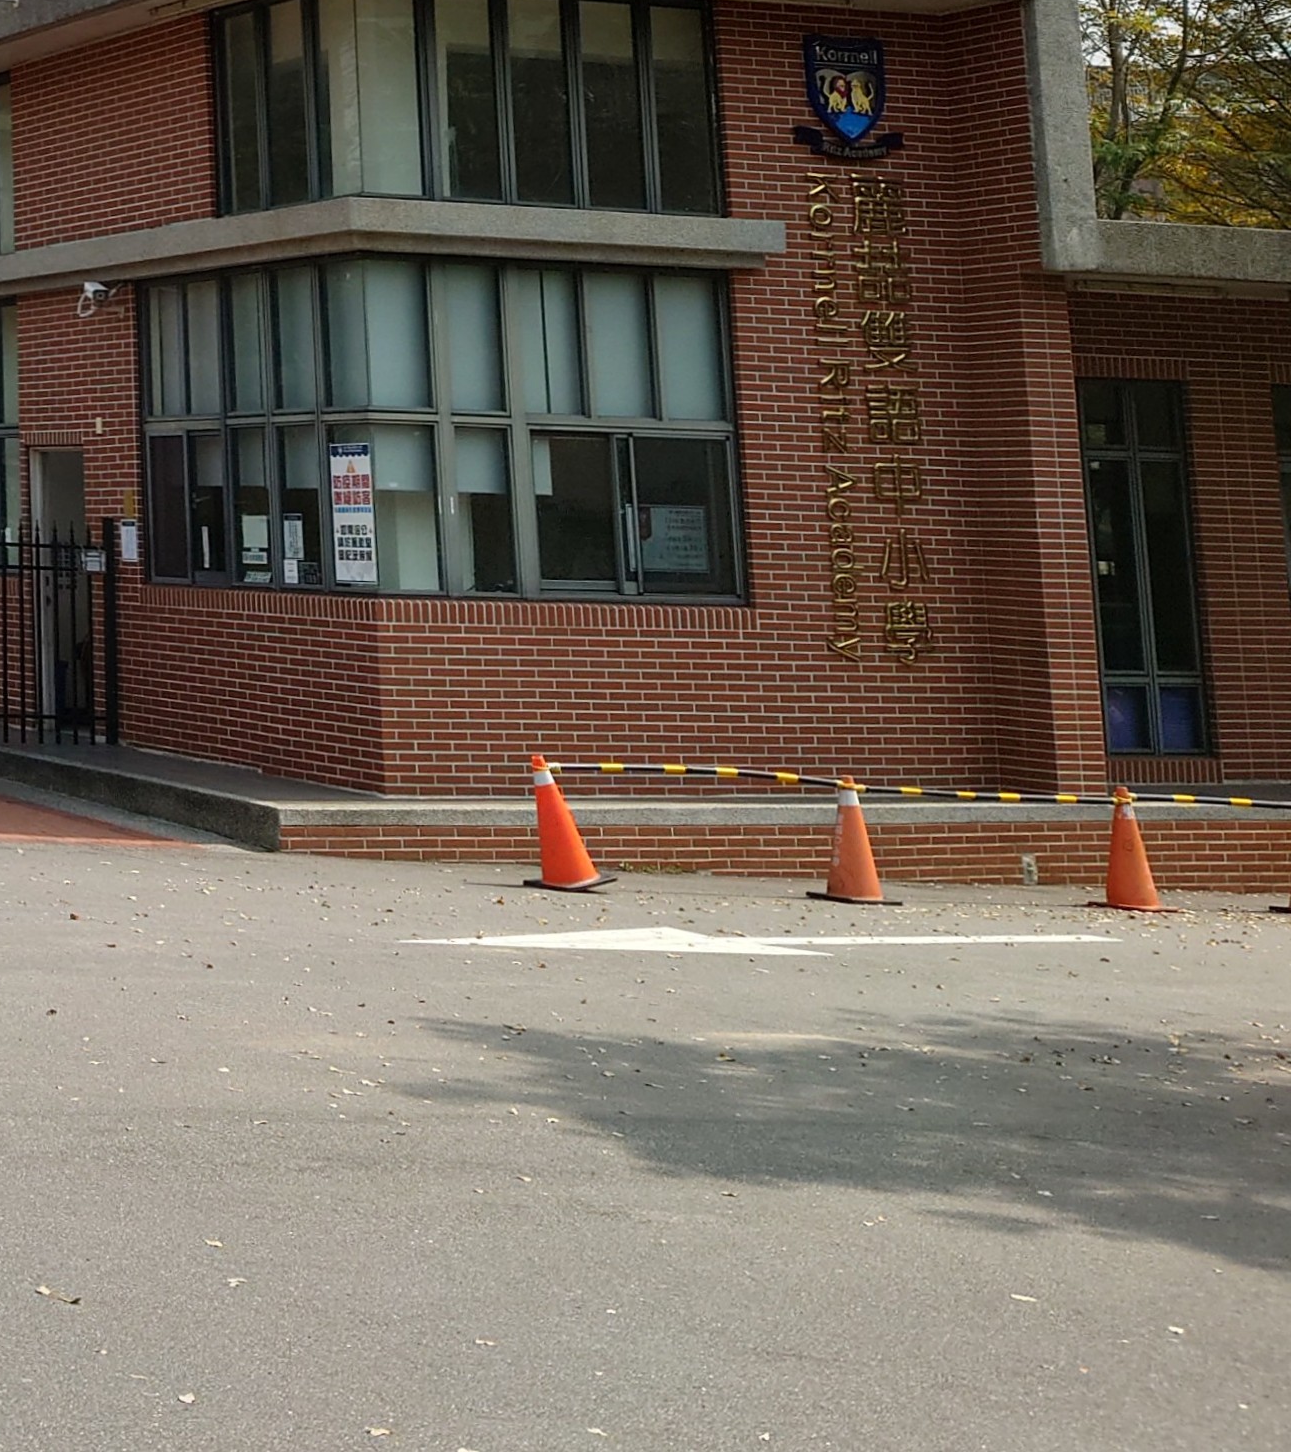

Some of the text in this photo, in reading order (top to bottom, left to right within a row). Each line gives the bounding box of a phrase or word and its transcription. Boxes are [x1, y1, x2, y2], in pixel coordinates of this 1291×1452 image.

[815, 45, 878, 64] Korrnell
[807, 172, 864, 662] Korrnell Ritz Academy
[851, 172, 934, 666] 麗喆雙語中小學
[333, 474, 370, 489] 防疫期間
[334, 491, 371, 506] 謝絕訪客
